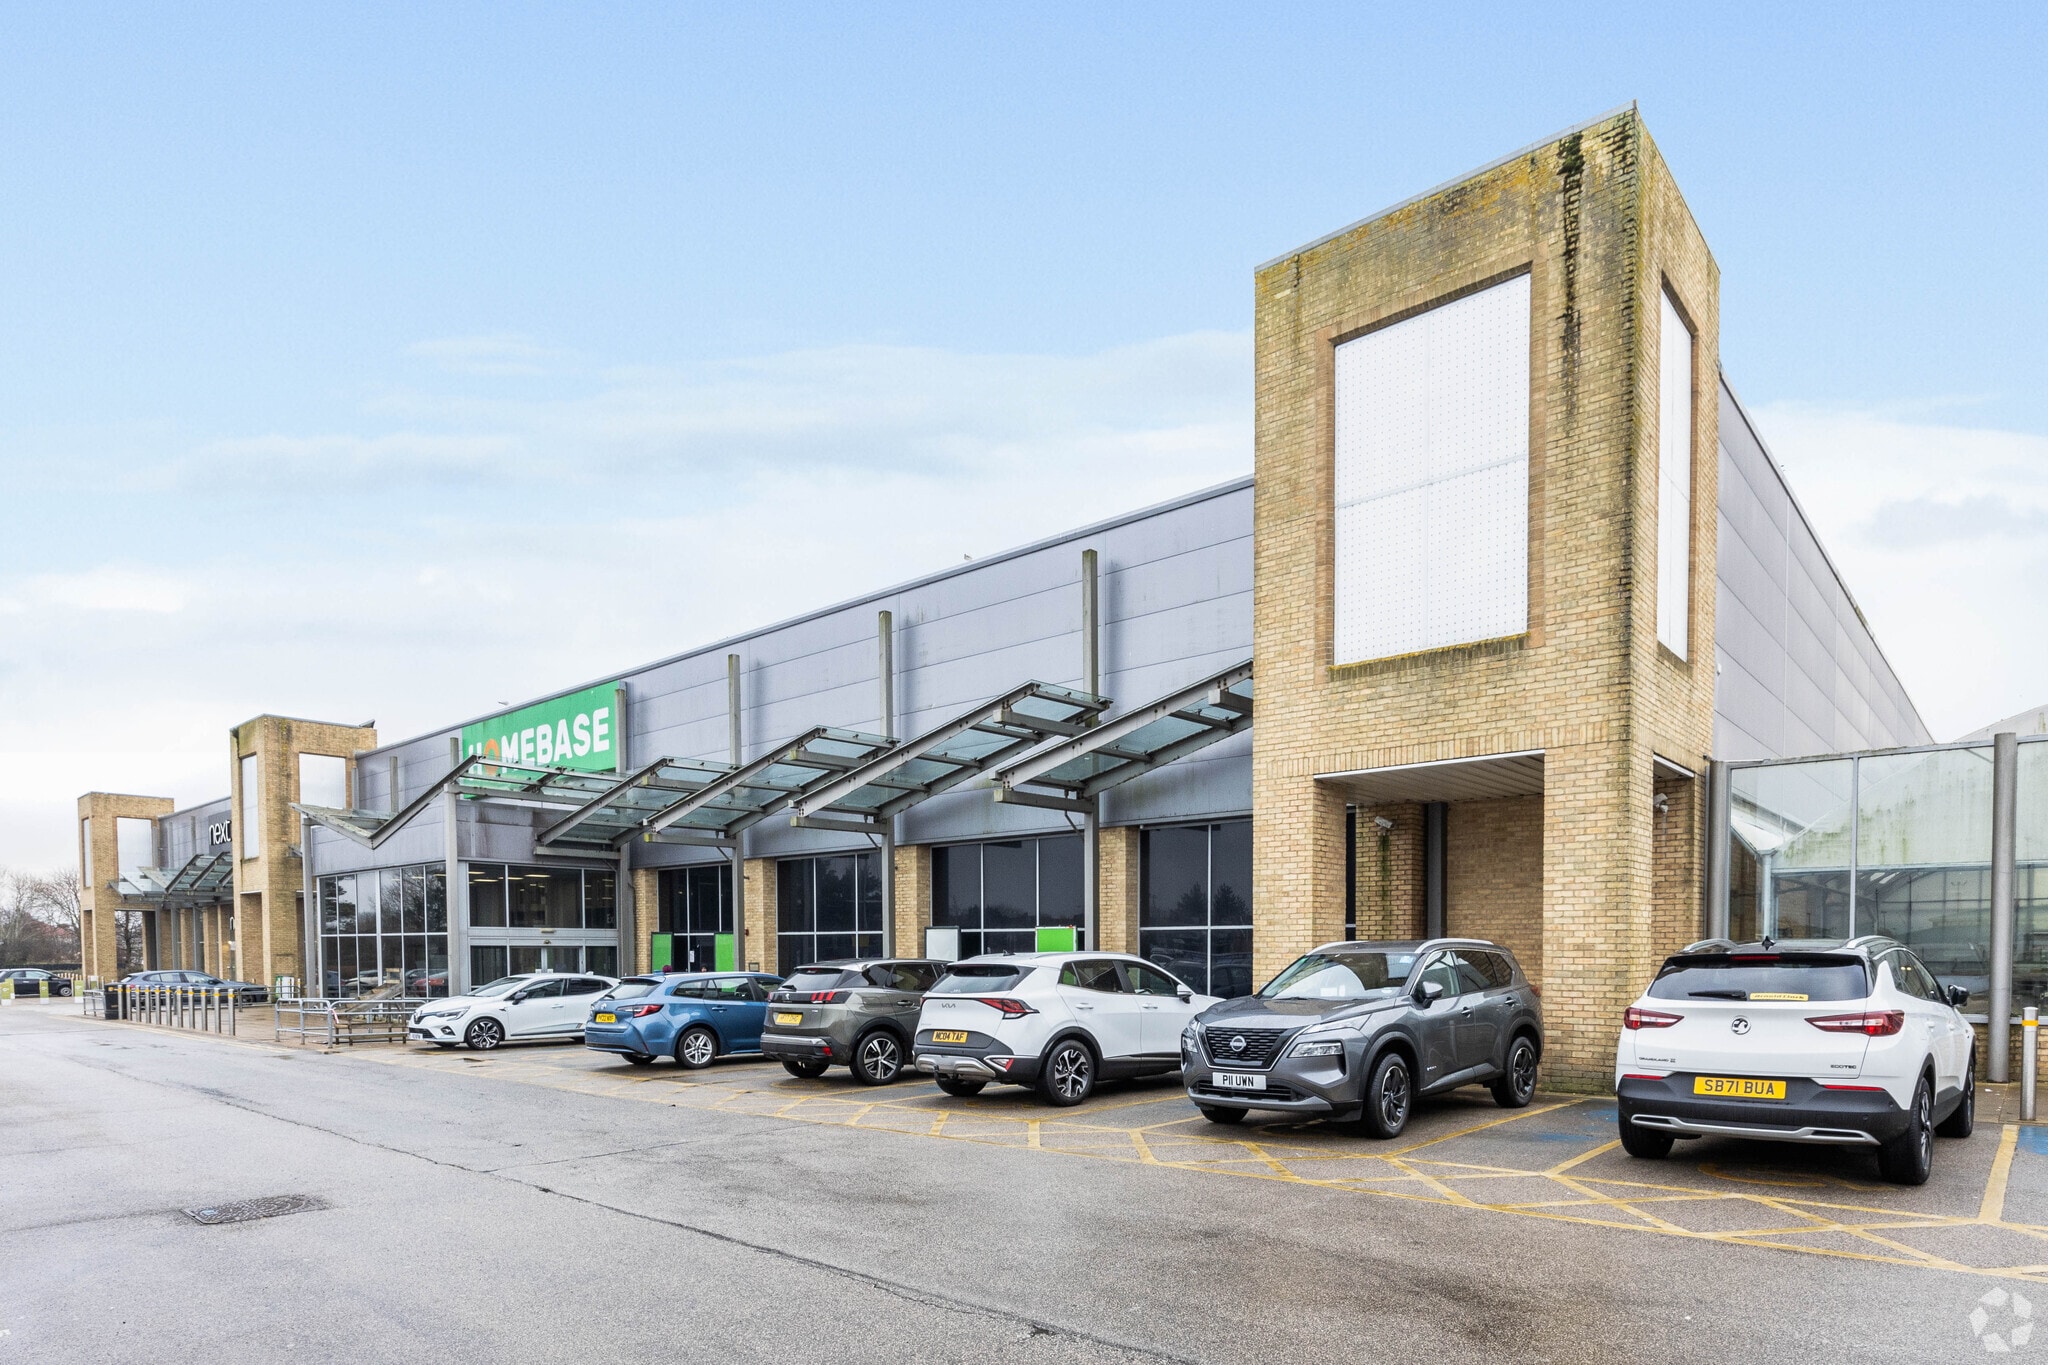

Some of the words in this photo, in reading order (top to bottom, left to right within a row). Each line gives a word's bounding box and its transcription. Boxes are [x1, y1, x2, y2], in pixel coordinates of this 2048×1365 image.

[468, 706, 610, 775] HOMEBASE
[209, 820, 231, 845] next
[1235, 1076, 1254, 1087] UWN
[1704, 1079, 1740, 1093] SB71
[1743, 1081, 1775, 1095] BUA
